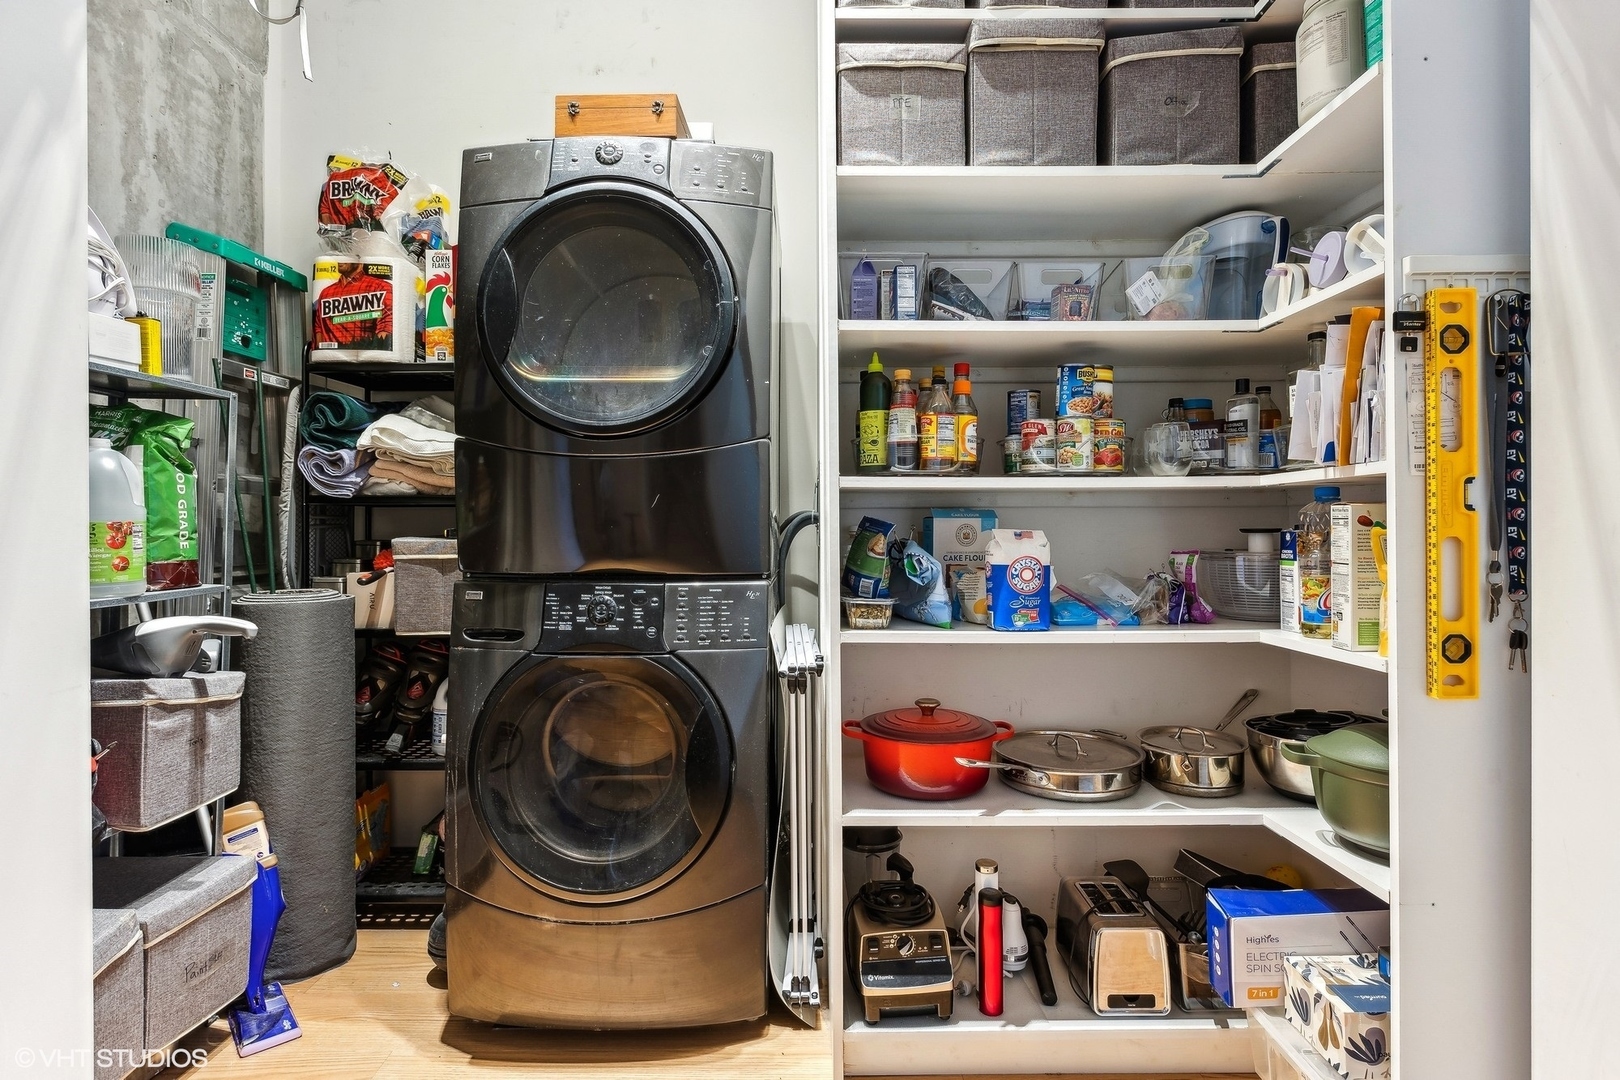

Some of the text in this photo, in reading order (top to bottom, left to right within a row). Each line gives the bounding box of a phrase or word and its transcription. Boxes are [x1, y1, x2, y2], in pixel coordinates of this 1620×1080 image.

[331, 177, 390, 203] BRAWNY
[432, 255, 450, 263] CORN
[260, 260, 285, 278] KELLER
[322, 293, 384, 317] BRAWNY
[1509, 334, 1516, 345] EY
[1508, 372, 1516, 384] EY
[95, 410, 123, 419] HARRIS
[1507, 411, 1516, 423] EY
[1179, 428, 1218, 441] HERSHEY'S
[1192, 440, 1209, 449] OCOA
[1507, 449, 1516, 461] EY
[1507, 488, 1516, 500] EY
[176, 499, 189, 549] GRADE
[1508, 526, 1517, 538] EY
[1012, 559, 1042, 577] CRYSTAL
[1510, 565, 1517, 576] EY
[1012, 576, 1041, 591] SUGAR
[1018, 595, 1042, 607] Sugar
[1246, 935, 1280, 945] HighYes
[185, 961, 208, 983] Paint
[1246, 964, 1272, 973] SPIN
[1259, 989, 1267, 997] in
[1269, 989, 1274, 997] 1
